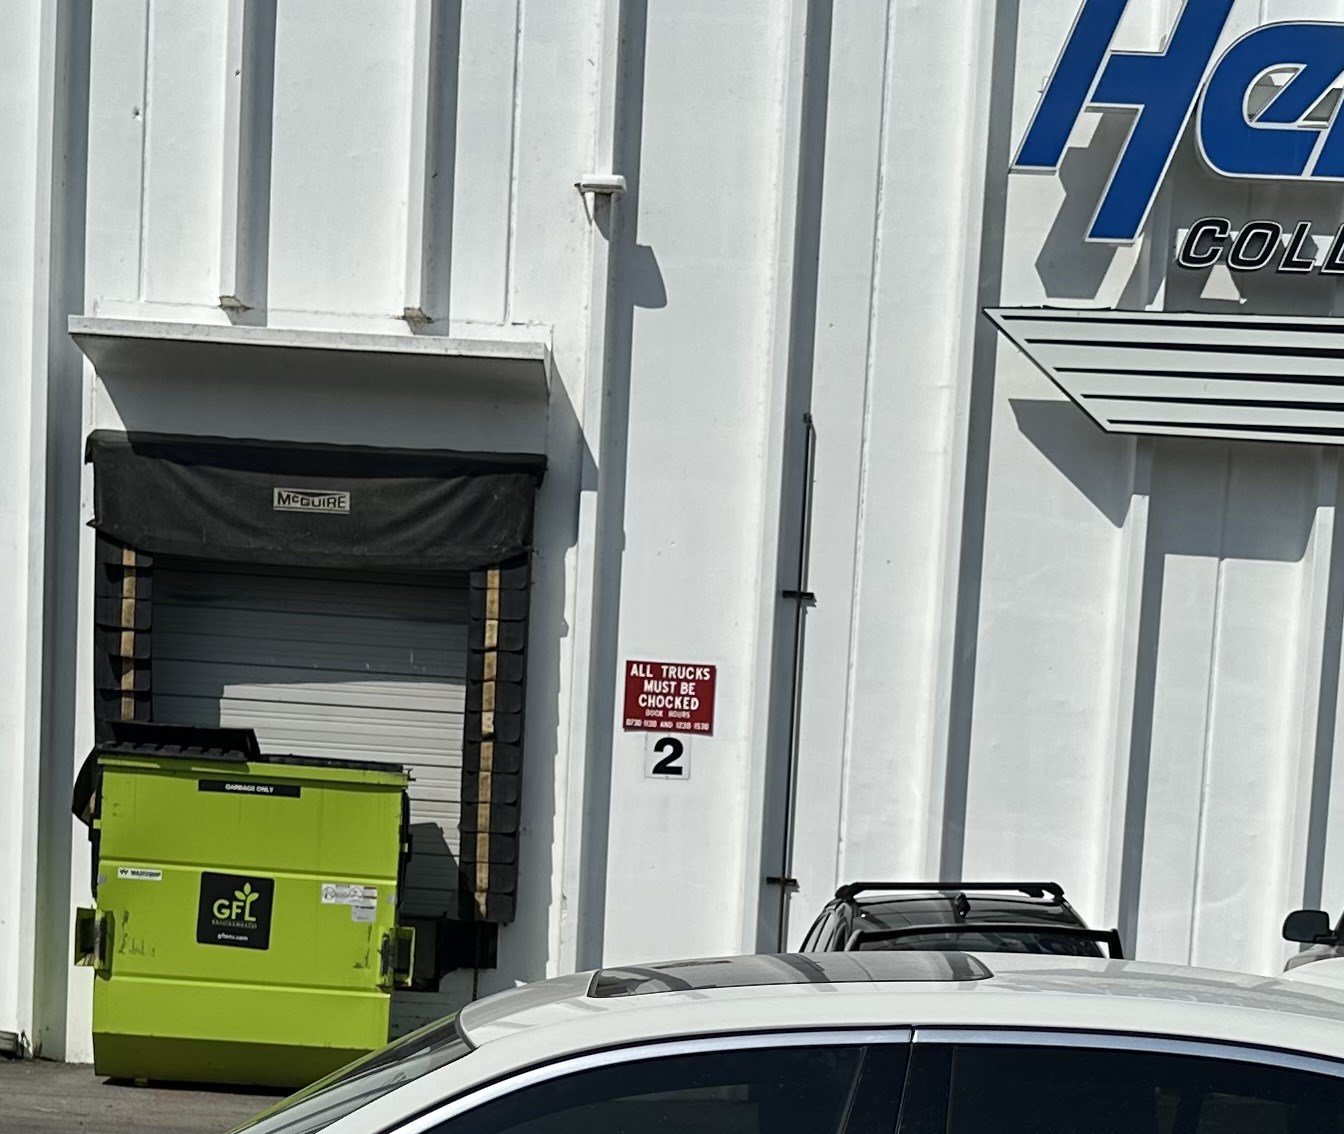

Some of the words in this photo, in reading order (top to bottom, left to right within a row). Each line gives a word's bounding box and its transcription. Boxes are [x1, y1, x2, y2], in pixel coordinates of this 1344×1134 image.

[630, 663, 654, 678] ALL
[660, 665, 711, 681] TRUCKS
[643, 679, 678, 694] MUST
[679, 681, 696, 696] BE
[638, 693, 700, 711] CHOCKED
[645, 708, 664, 718] DOCK
[668, 710, 691, 719] HOURS
[660, 721, 674, 729] AND
[652, 736, 684, 776] 2
[256, 785, 274, 794] ONLY
[212, 897, 257, 922] GFL
